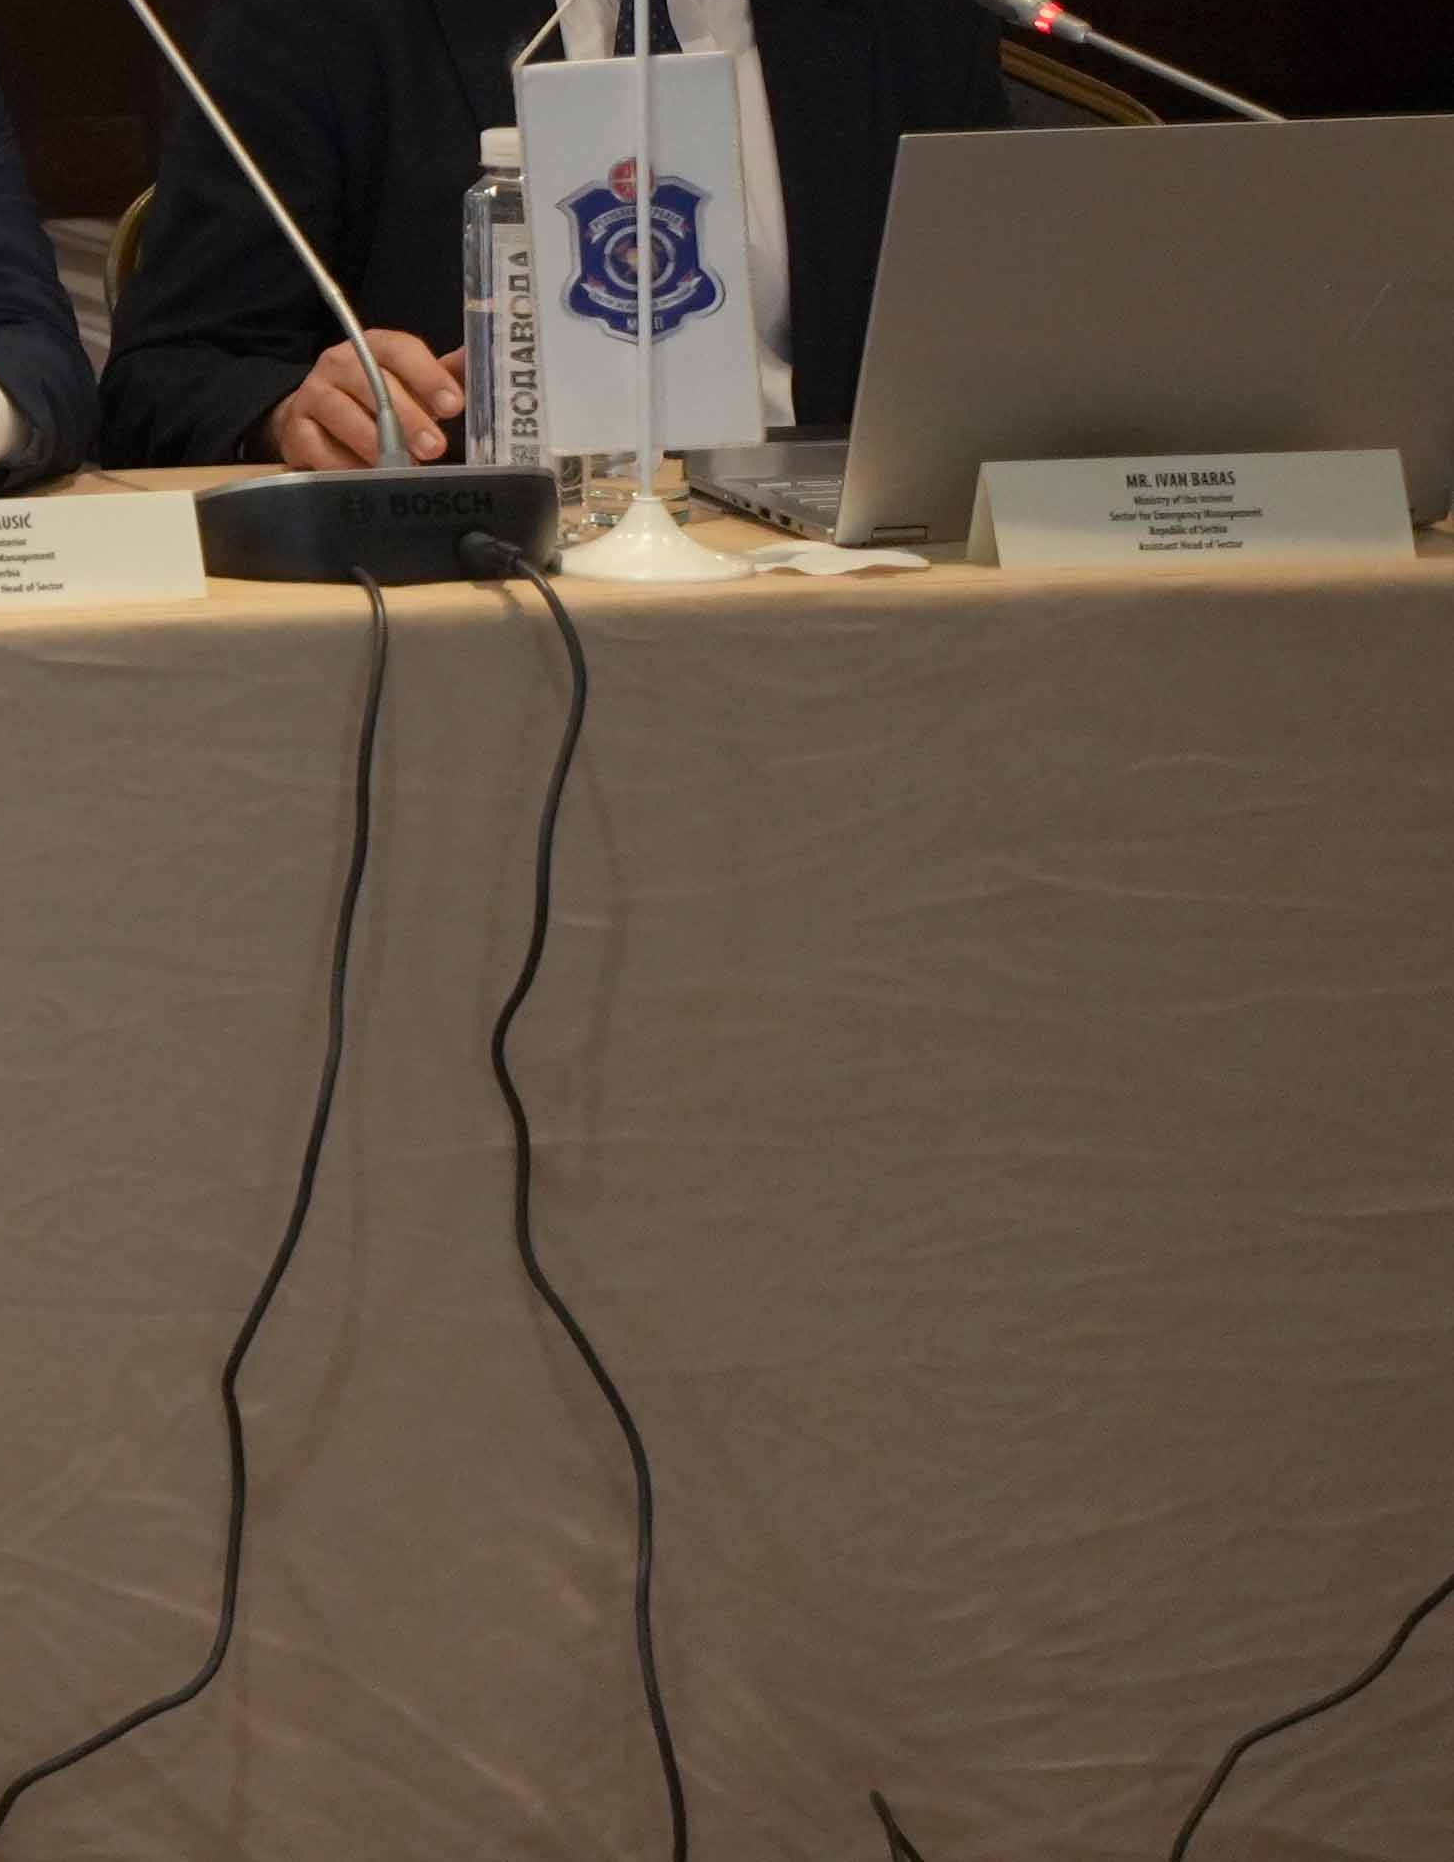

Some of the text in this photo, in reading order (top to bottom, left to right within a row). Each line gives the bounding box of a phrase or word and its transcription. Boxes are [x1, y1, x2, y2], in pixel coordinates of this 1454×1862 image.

[509, 250, 540, 439] ВОДАВОДА
[1125, 474, 1152, 488] MR.
[1155, 472, 1188, 488] IVAN
[390, 491, 494, 517] BOSCH
